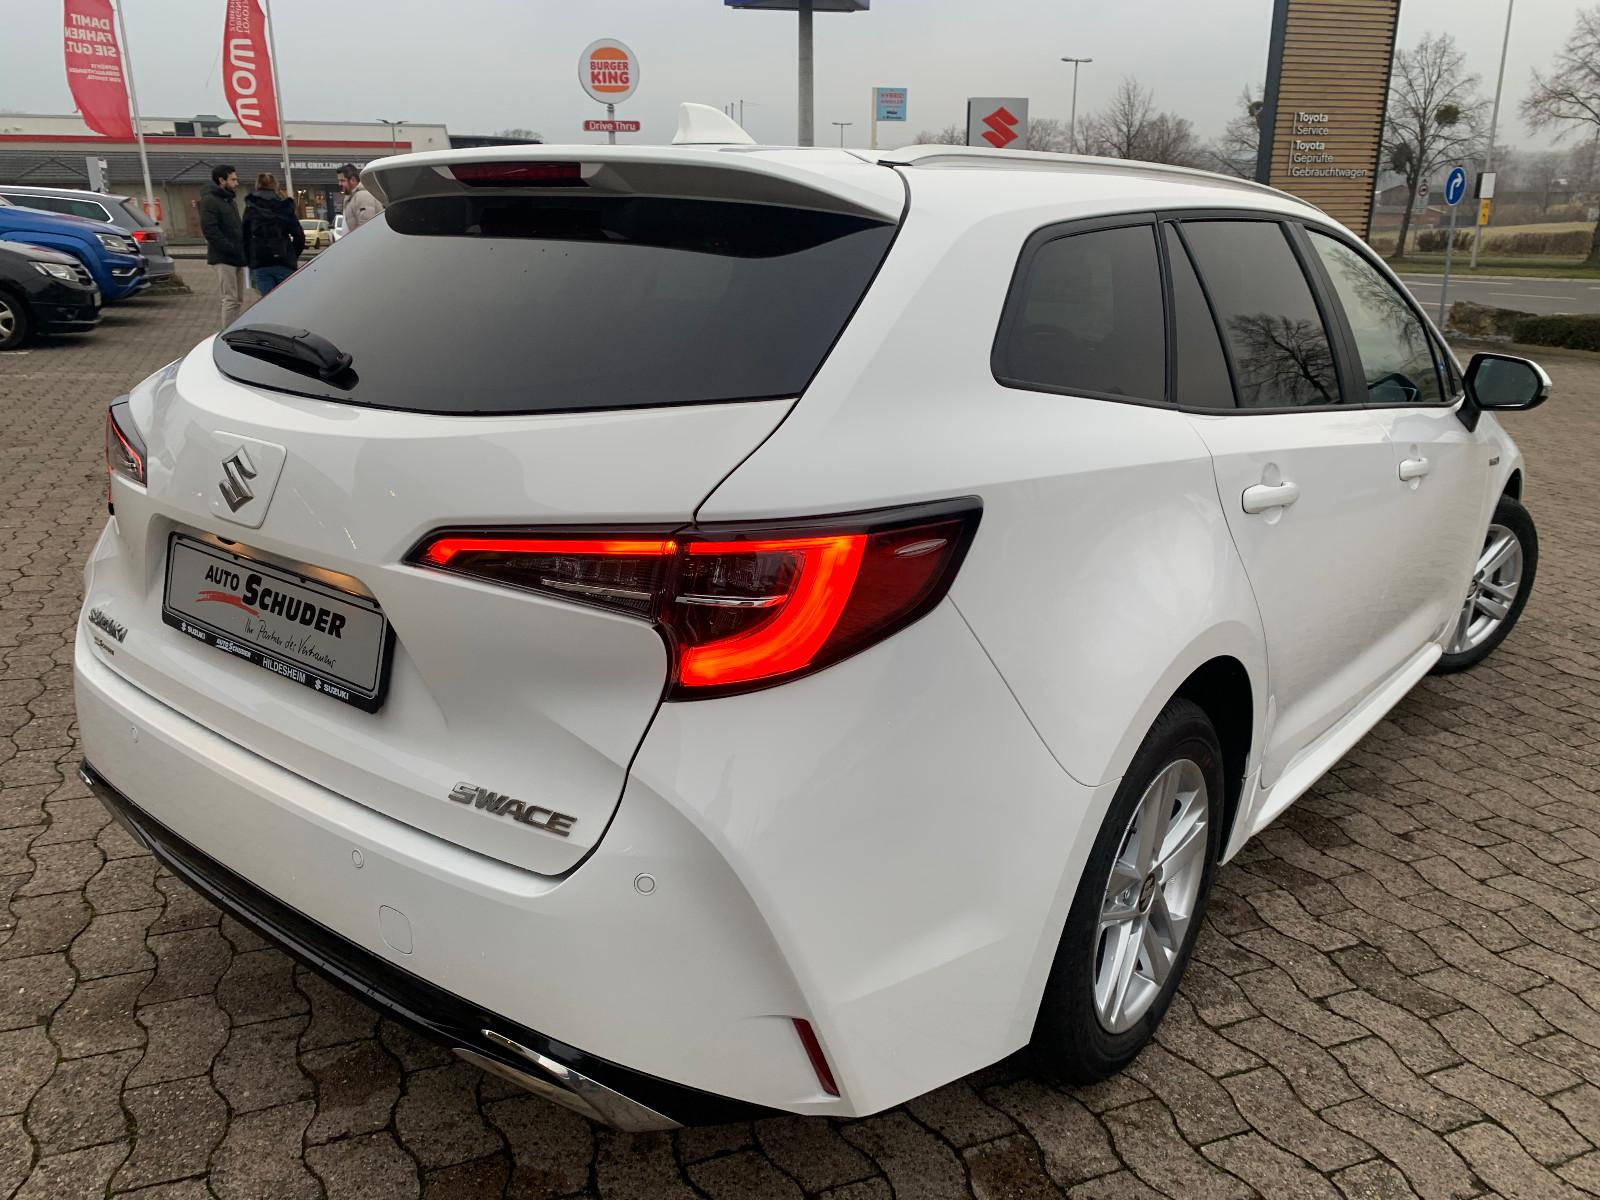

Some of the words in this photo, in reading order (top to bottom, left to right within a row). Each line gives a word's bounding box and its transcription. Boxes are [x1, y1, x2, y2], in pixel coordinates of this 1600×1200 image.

[590, 61, 629, 71] BURGER
[591, 71, 630, 84] KING
[1299, 112, 1329, 124] Toyota
[589, 121, 614, 131] Drive
[615, 122, 637, 132] Thru
[1297, 126, 1329, 136] Service
[1295, 140, 1325, 152] Toyota
[1292, 166, 1368, 179] Gebrauchtwagen
[205, 565, 240, 592] AUTO
[187, 625, 206, 640] SUZUKI
[262, 656, 306, 684] HILDESHEIM
[323, 683, 349, 700] SUZUKI
[448, 781, 578, 838] SWACE
